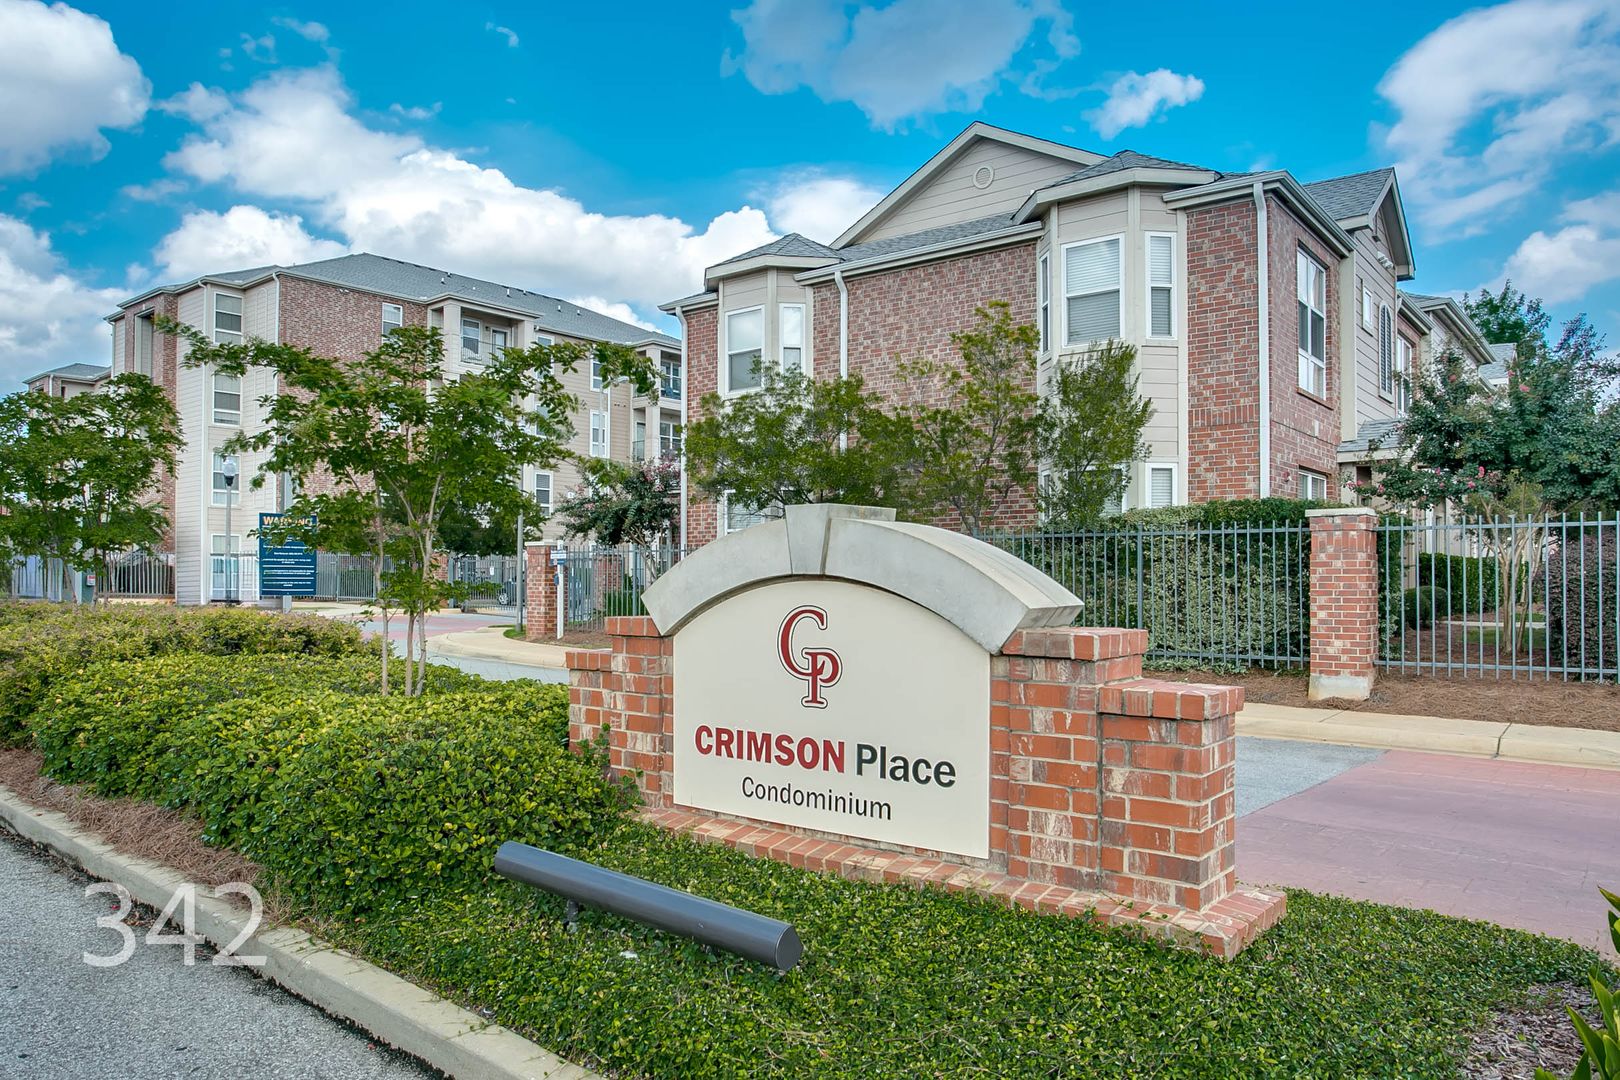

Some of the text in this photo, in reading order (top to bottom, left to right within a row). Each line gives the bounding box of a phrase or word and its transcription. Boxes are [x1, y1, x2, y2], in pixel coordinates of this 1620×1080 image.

[695, 724, 956, 787] CRIMSON Place
[742, 776, 891, 820] Condominium
